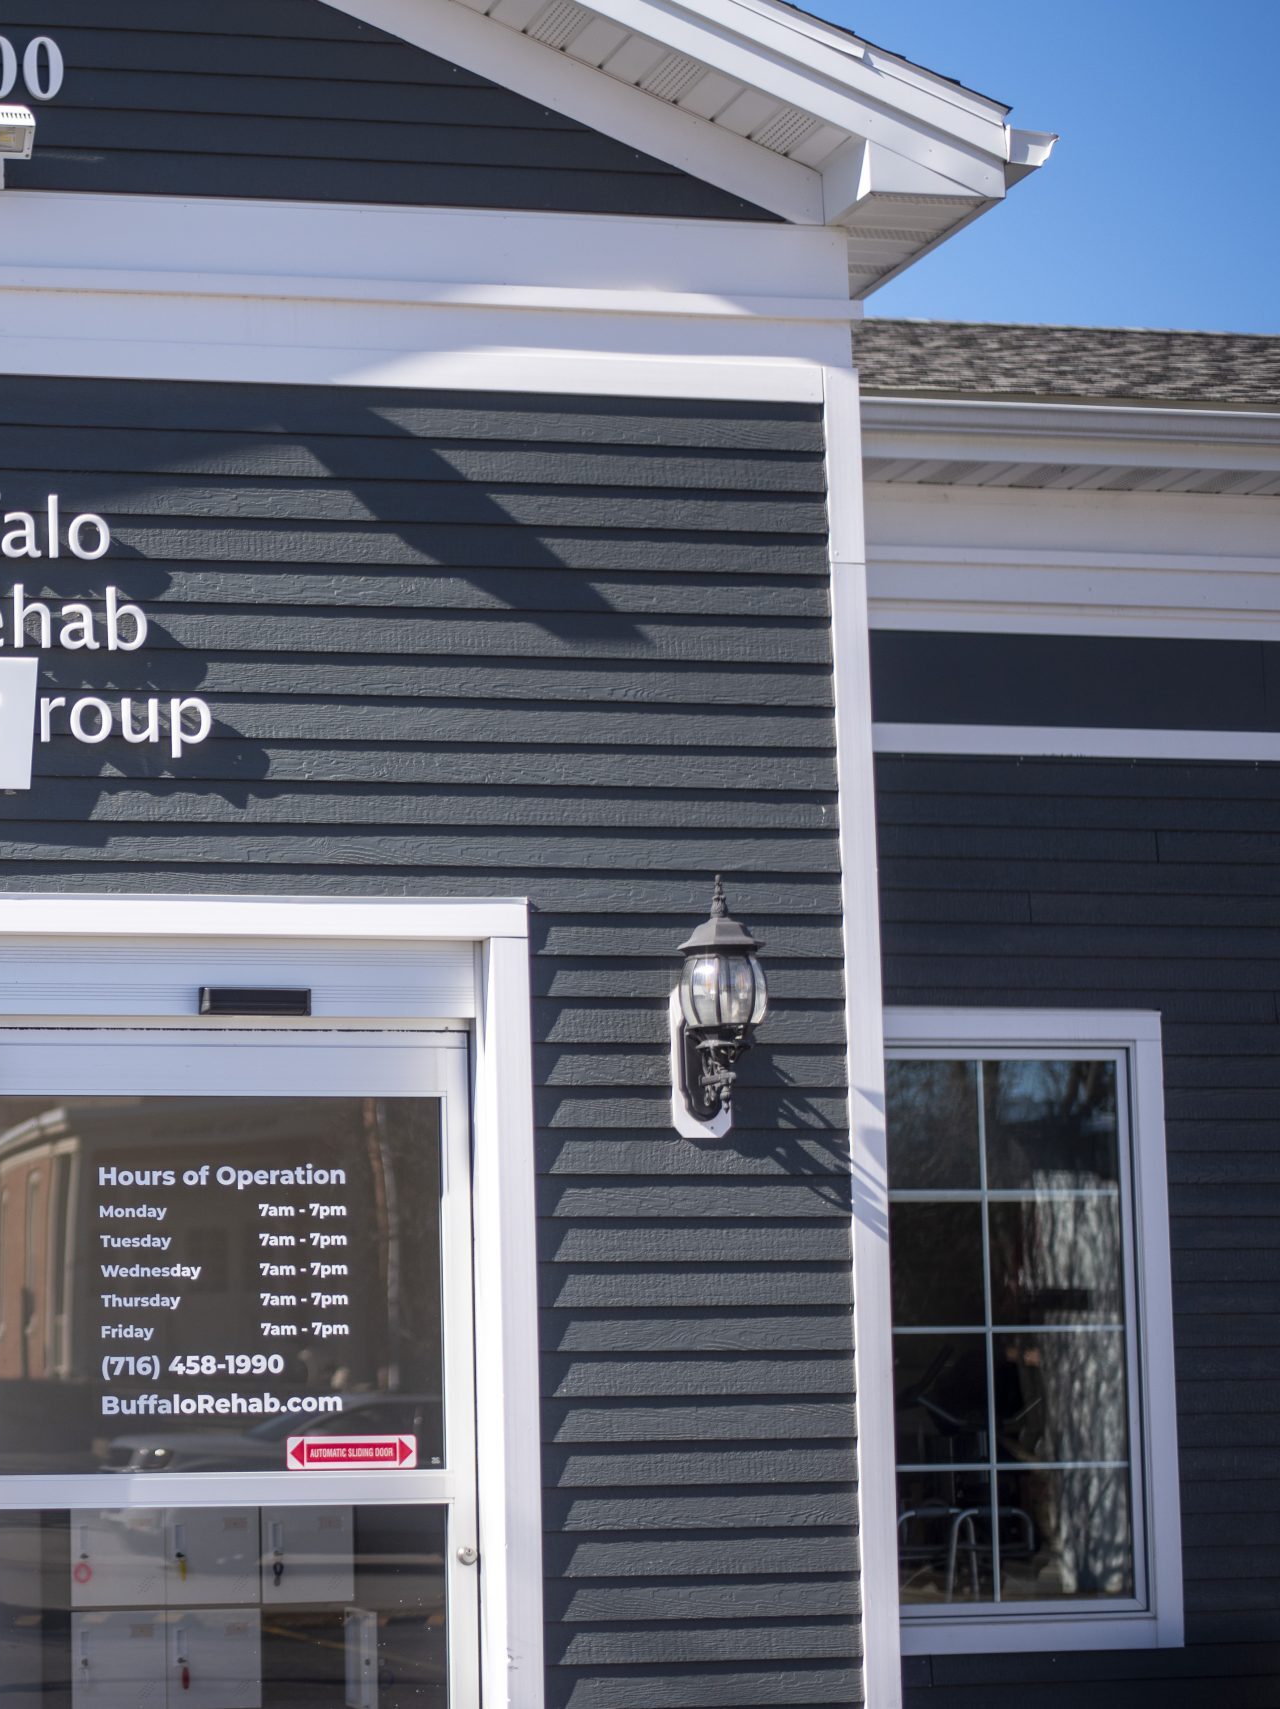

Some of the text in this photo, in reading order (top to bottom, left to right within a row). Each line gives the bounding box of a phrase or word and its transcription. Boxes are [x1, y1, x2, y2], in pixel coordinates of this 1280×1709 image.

[99, 1164, 345, 1189] Hours of Operation
[100, 1205, 167, 1220] Monday
[259, 1204, 294, 1216] 7am
[309, 1204, 346, 1219] 7pm
[100, 1234, 171, 1250] Tuesday
[259, 1234, 295, 1246] 7am
[310, 1233, 347, 1248] 7pm
[101, 1264, 201, 1280] Wednesday
[260, 1263, 295, 1275] 7am
[311, 1263, 347, 1278] 7pm
[101, 1294, 180, 1309] Thursday
[260, 1293, 296, 1305] 7am
[311, 1293, 348, 1308] 7pm
[102, 1324, 154, 1340] Friday
[261, 1323, 297, 1335] 7am
[312, 1322, 349, 1337] 7pm
[102, 1354, 284, 1380] (716) 458-1990
[102, 1393, 342, 1414] BuffaloRehab.com
[310, 1447, 393, 1458] AUTOMATIC SLIDING DOOR
